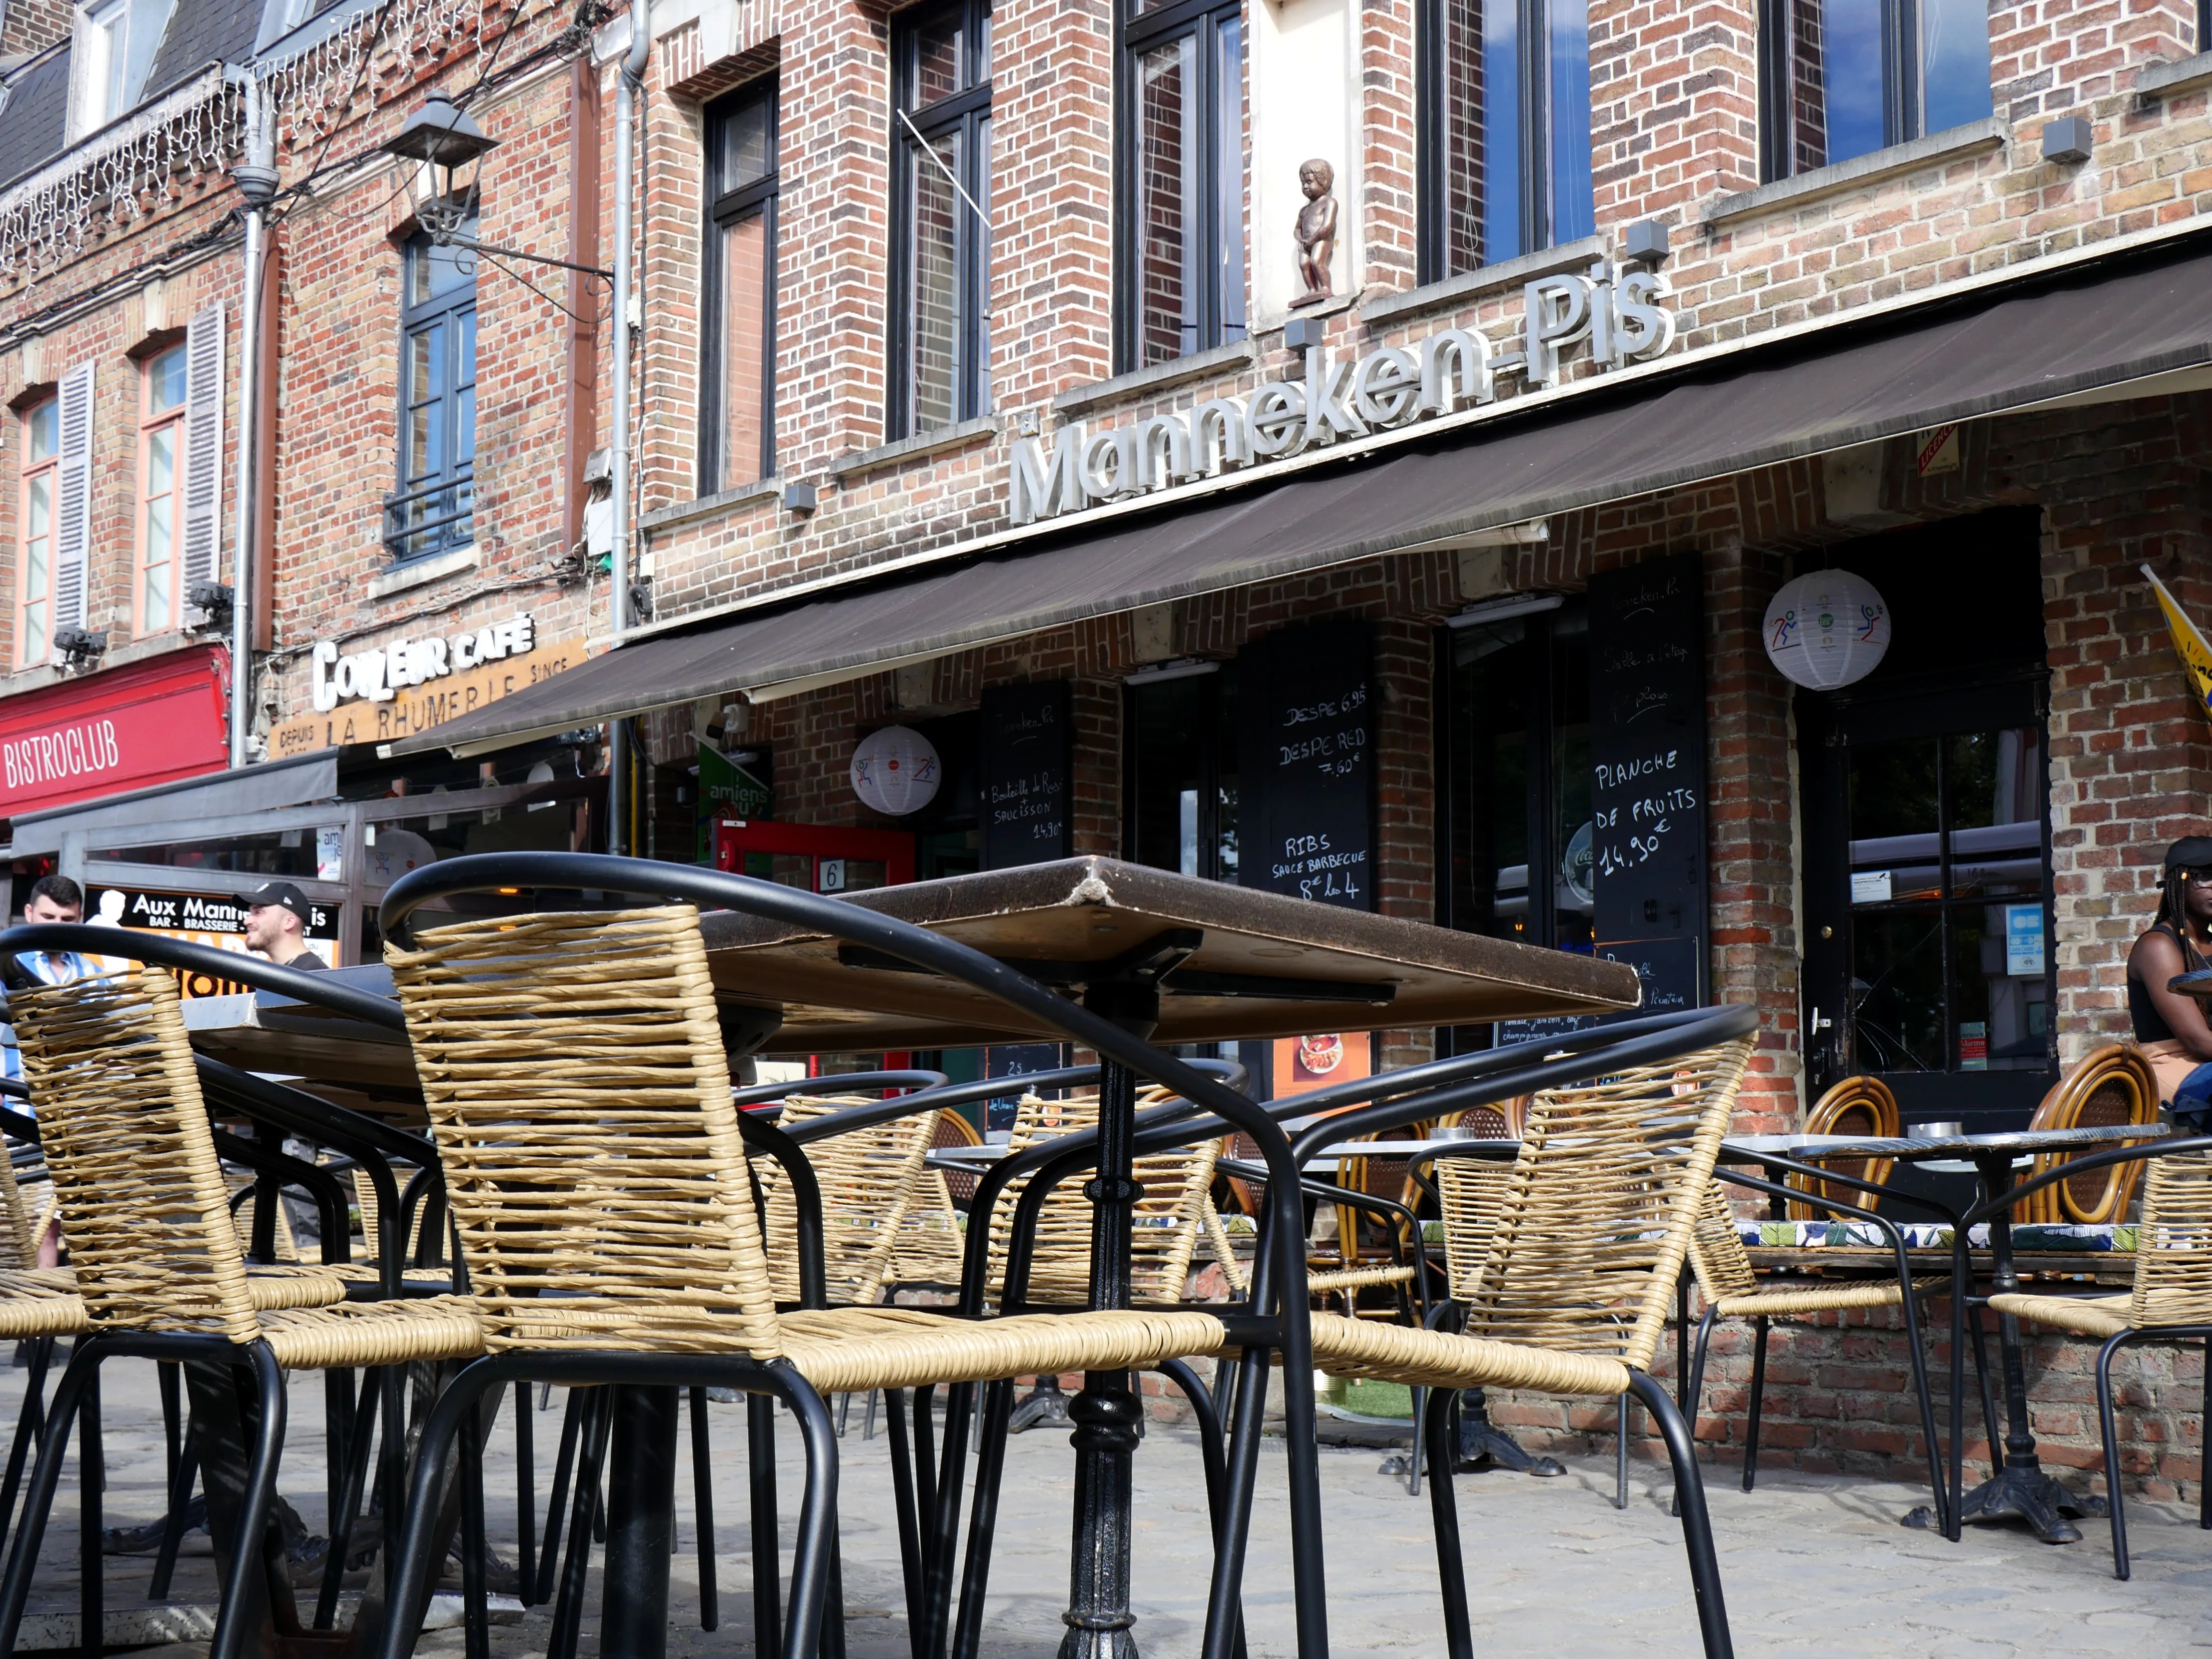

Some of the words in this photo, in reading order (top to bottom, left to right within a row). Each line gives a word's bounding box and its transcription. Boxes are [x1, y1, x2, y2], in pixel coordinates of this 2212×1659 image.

[454, 612, 535, 669] CAFÉ
[1282, 701, 1338, 727] DESPE
[279, 725, 313, 749] DEPUIS
[326, 718, 356, 747] LA
[3, 720, 119, 789] BISTROCLUB
[1279, 736, 1334, 766] DESPE
[1336, 728, 1365, 750] RED
[1595, 749, 1677, 790] PLANCHE
[710, 781, 769, 804] amiens
[1596, 807, 1619, 830] DE
[1285, 833, 1331, 858] RIBS
[827, 863, 838, 887] 6
[1272, 861, 1304, 879] SAUCE
[1306, 849, 1367, 873] BARBECUE
[1345, 871, 1360, 899] 4
[132, 893, 175, 916] Aux
[149, 915, 170, 928] BAR
[184, 918, 238, 932] BRASSERIE
